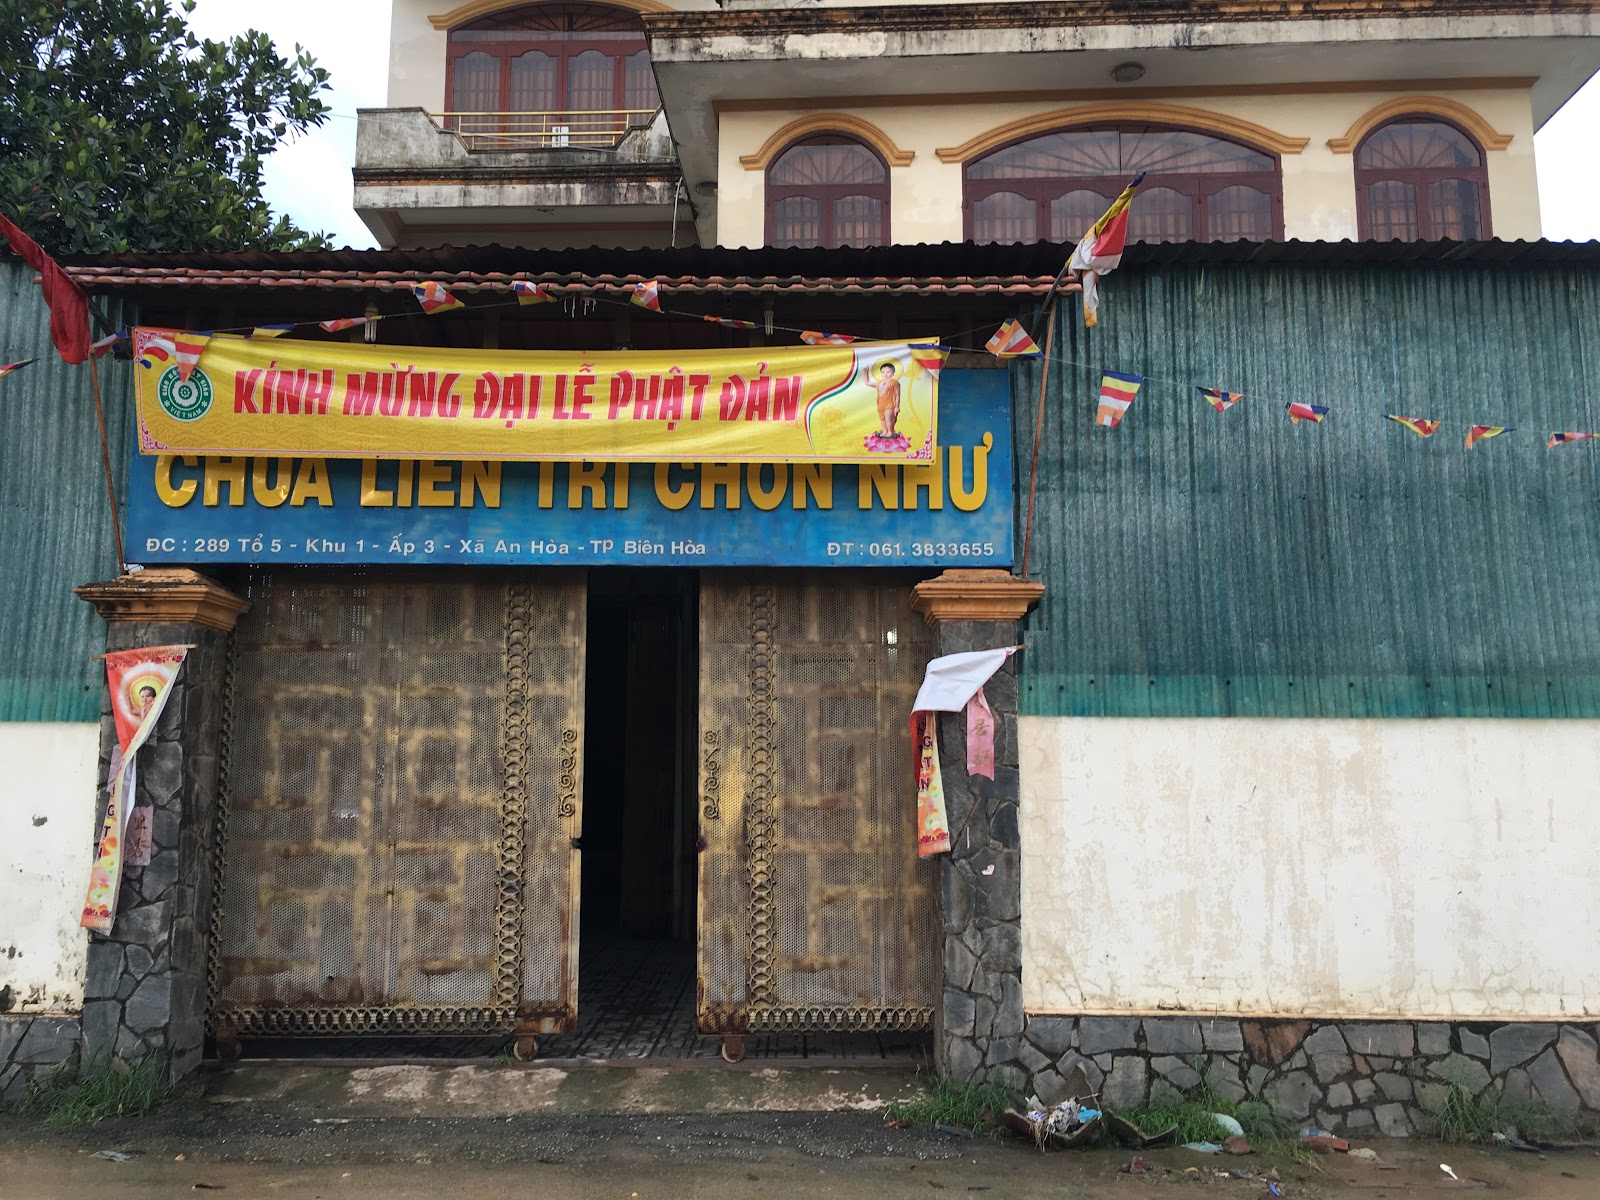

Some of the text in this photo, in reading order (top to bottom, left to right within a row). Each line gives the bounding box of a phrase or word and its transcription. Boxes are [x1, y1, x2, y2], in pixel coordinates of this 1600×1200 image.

[234, 361, 804, 431] KÍNH MỪNG ĐẠI LỄ PHẬT ĐẢN
[858, 431, 994, 512] NHƯ
[194, 538, 230, 553] 289
[238, 533, 264, 553] Tổ
[271, 538, 282, 553] 5
[306, 538, 346, 553] Khu
[356, 539, 364, 553] 1
[388, 533, 416, 556] Ấp
[424, 539, 435, 554] 3
[459, 539, 485, 554] Xã
[494, 539, 521, 554] An
[530, 540, 569, 555] Hòa
[624, 540, 665, 555] Biên
[671, 539, 706, 555] Hòa
[911, 542, 994, 557] 3833655
